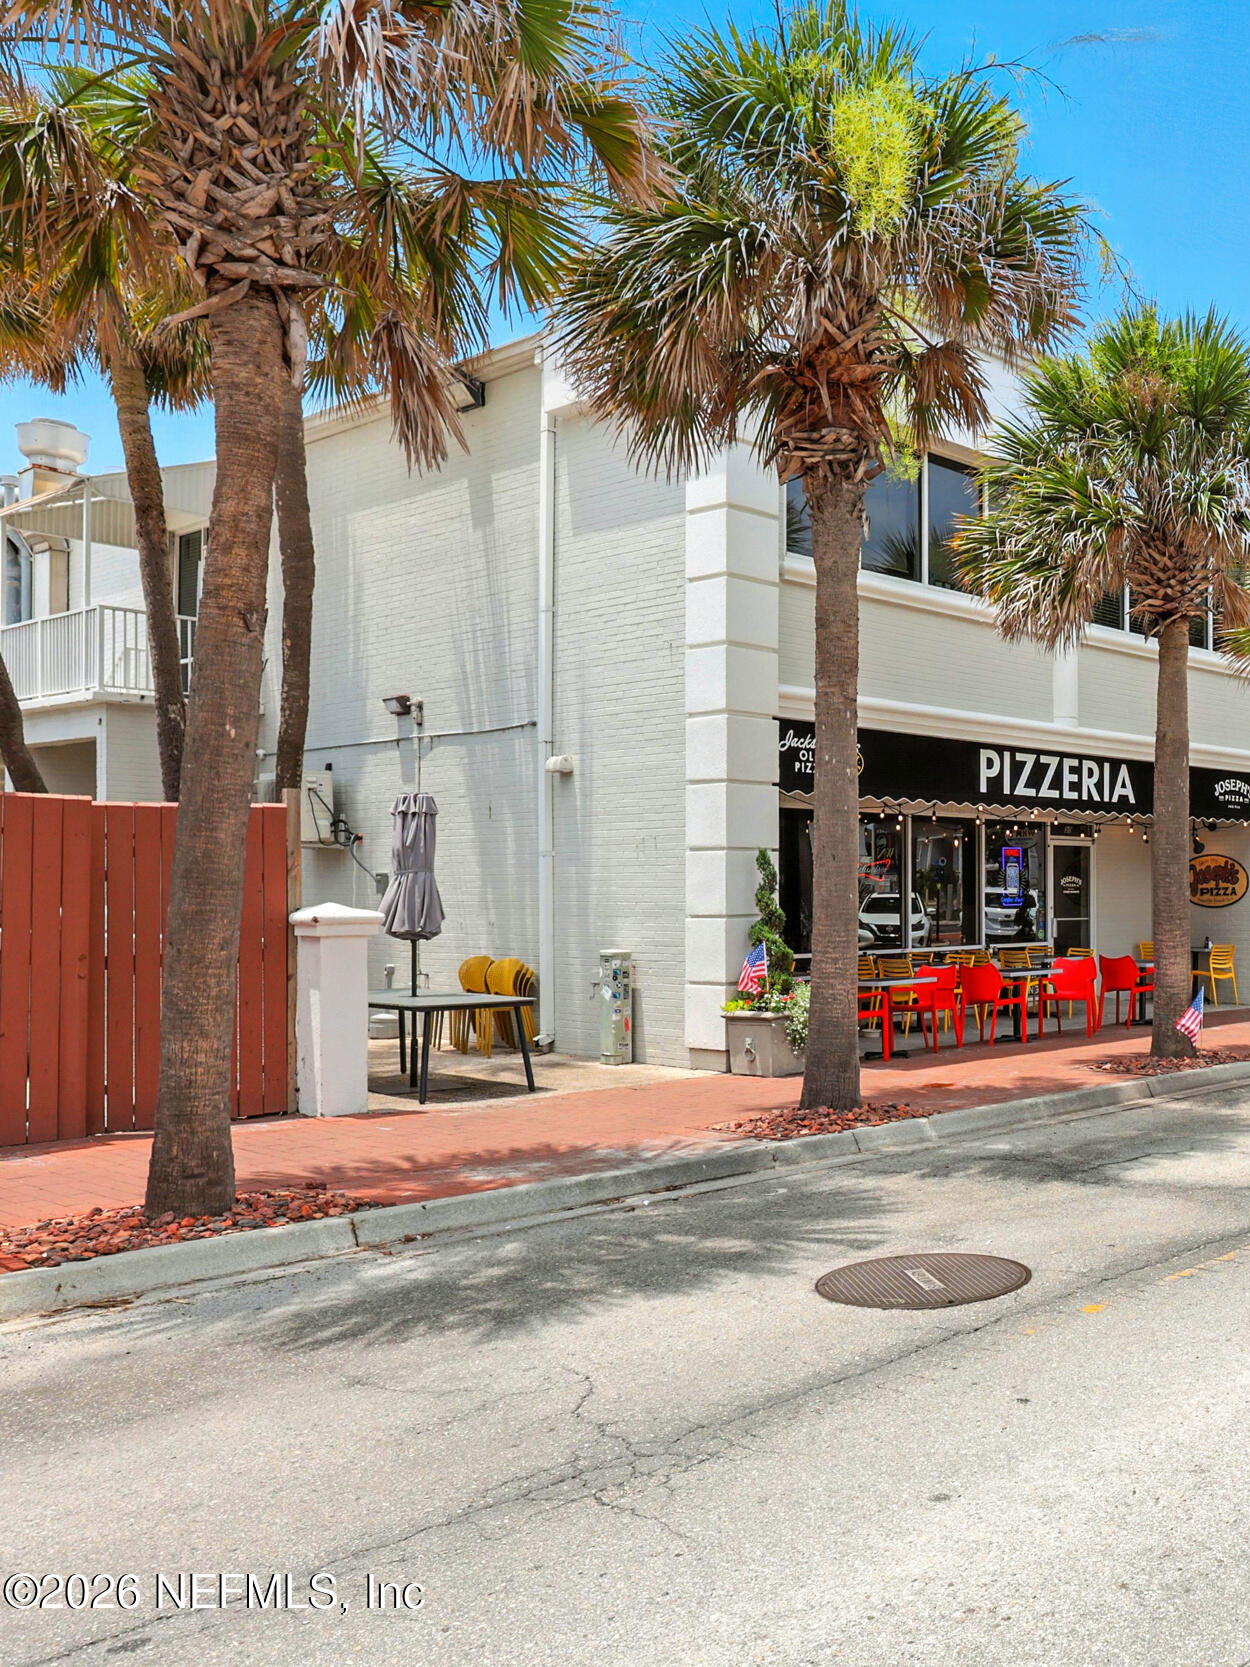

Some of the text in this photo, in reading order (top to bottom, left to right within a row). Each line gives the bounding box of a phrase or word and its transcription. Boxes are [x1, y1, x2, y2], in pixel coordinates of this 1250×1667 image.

[779, 729, 816, 751] Jacks
[980, 749, 1136, 804] PIZZERIA
[1225, 794, 1244, 803] PIZZA
[1200, 887, 1238, 896] PIZZA
